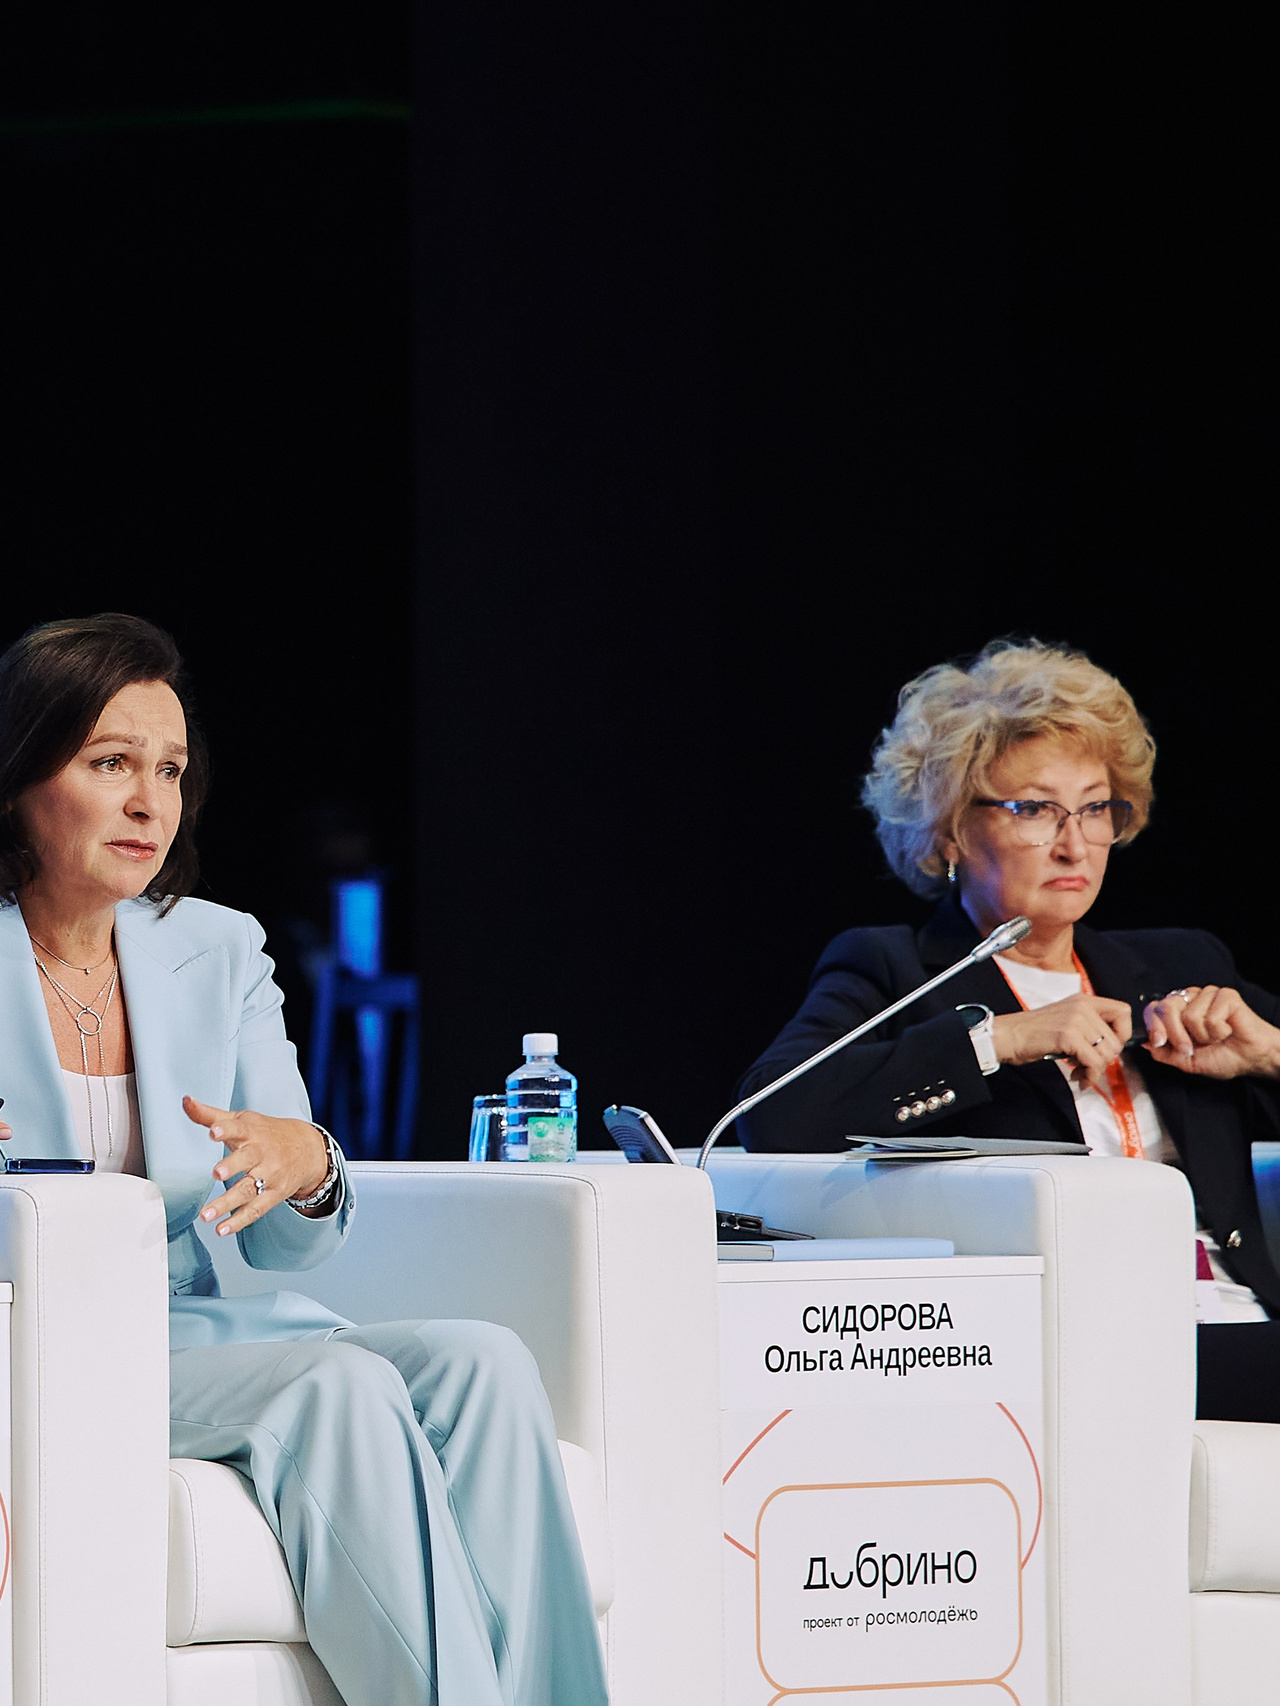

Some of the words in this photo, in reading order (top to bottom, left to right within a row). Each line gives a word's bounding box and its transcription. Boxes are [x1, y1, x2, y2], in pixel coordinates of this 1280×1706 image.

[802, 1303, 954, 1340] СИДОРОВА
[765, 1345, 844, 1373] Ольга
[850, 1342, 993, 1376] Андреевна
[803, 1615, 843, 1631] проект
[846, 1615, 860, 1627] от
[865, 1606, 978, 1632] росмолодёжь
